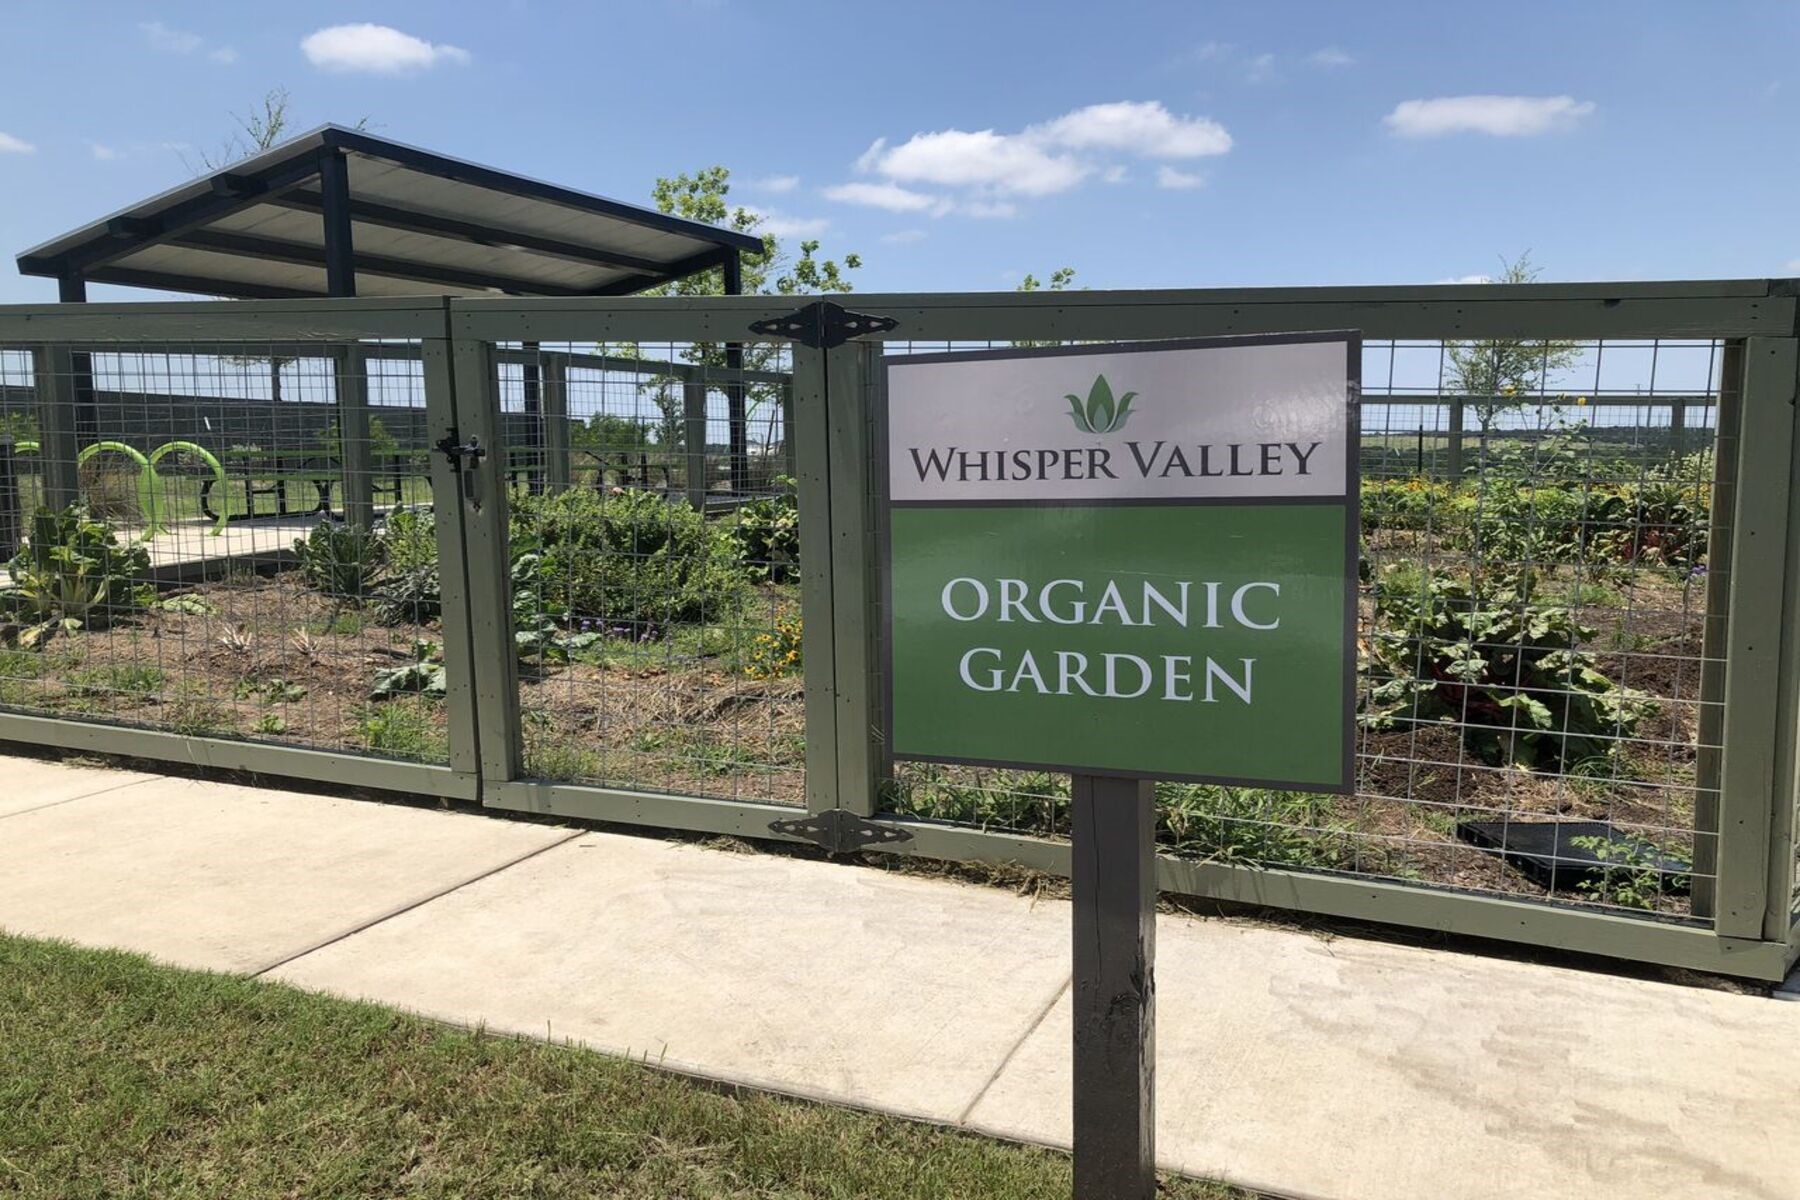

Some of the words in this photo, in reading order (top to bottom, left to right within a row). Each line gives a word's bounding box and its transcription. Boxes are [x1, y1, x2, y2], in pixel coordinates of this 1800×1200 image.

[909, 446, 1120, 483] WHISPER
[1123, 441, 1322, 479] VALLEY
[941, 577, 1281, 630] ORGANIC
[959, 647, 1257, 705] GARDEN
